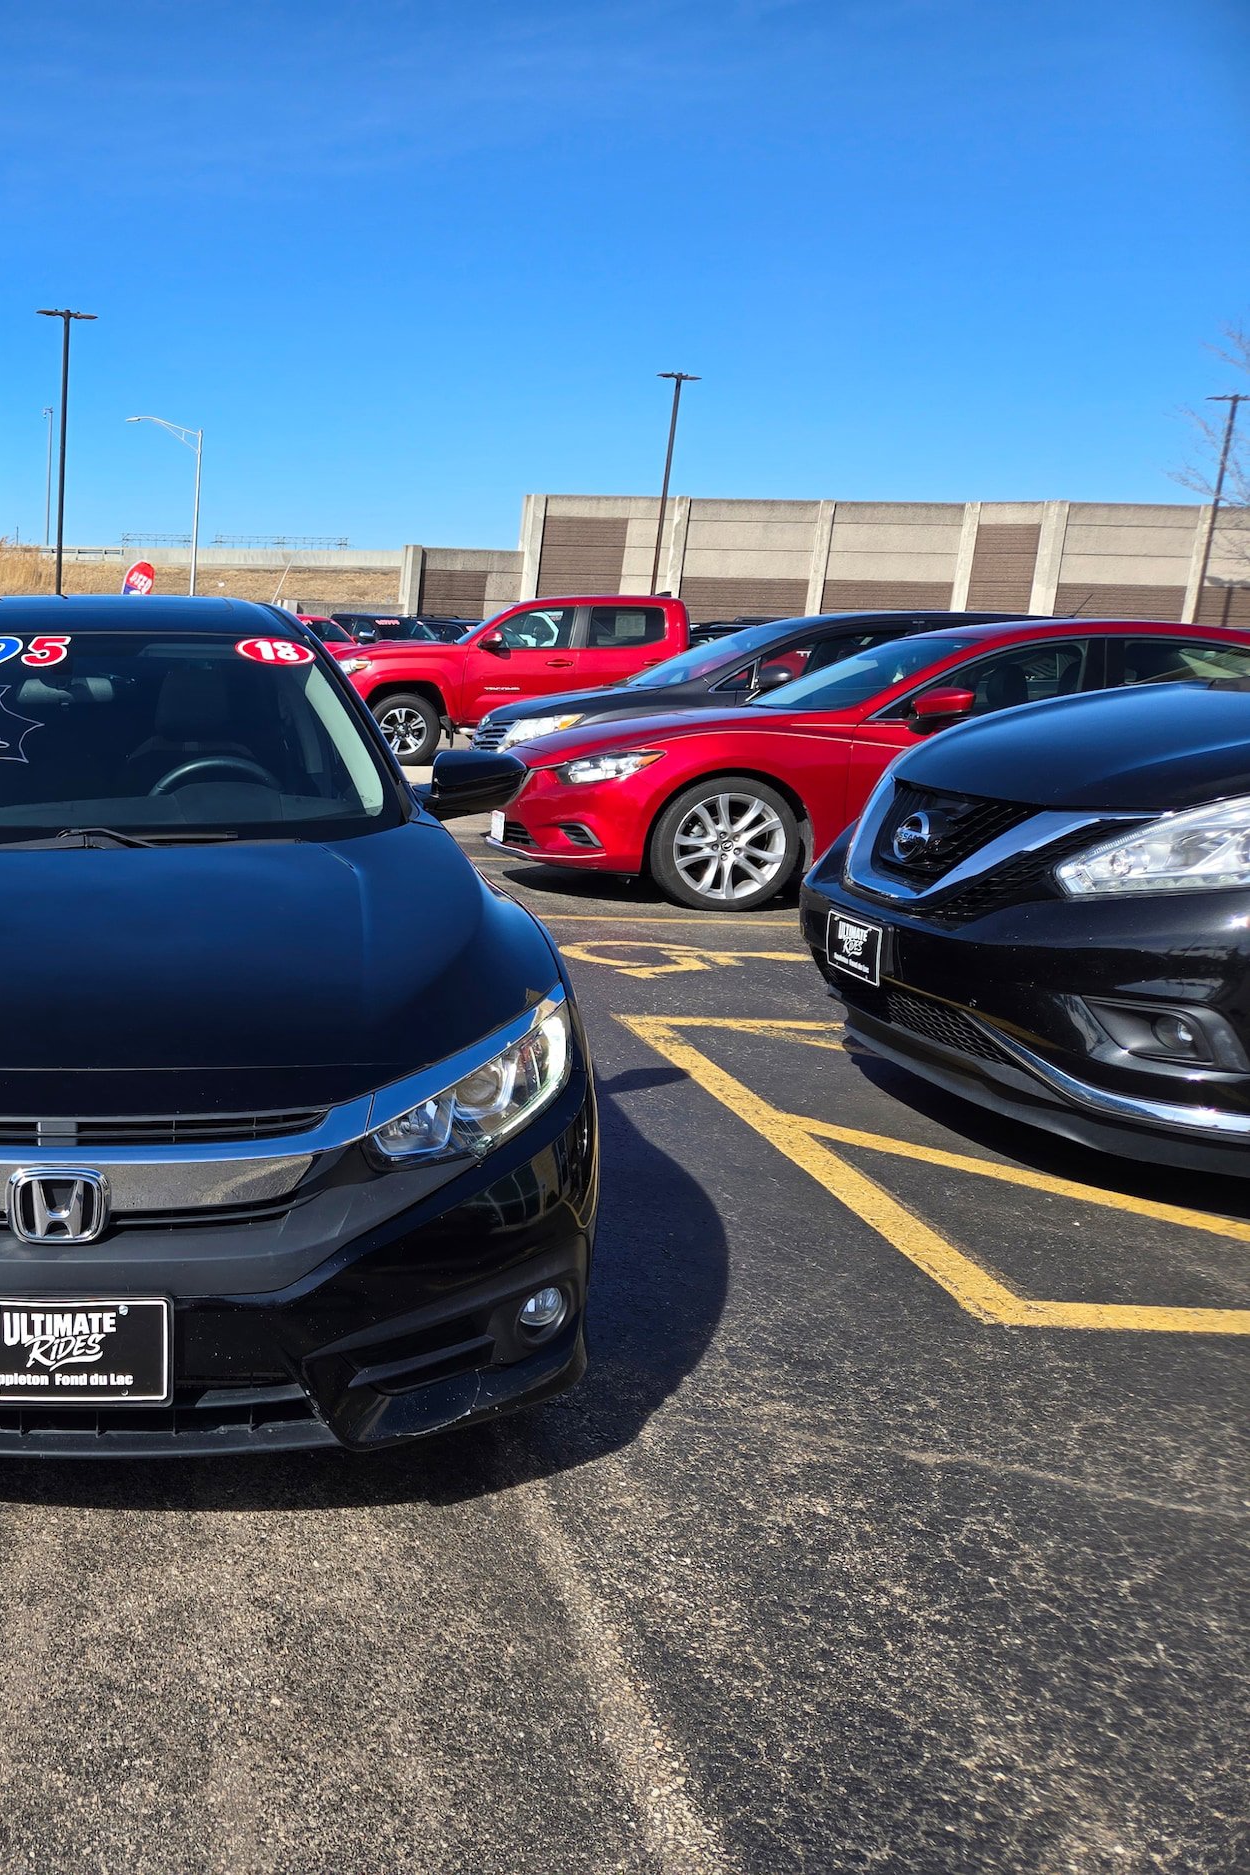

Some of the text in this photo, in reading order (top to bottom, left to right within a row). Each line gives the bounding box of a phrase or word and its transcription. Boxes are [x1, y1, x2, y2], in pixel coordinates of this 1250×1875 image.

[254, 640, 300, 661] 18
[838, 920, 868, 942] ULTIMATE
[3, 1311, 116, 1346] ULTIMATE
[24, 1333, 106, 1371] RIDES
[54, 1372, 88, 1386] Fond
[89, 1372, 108, 1386] du
[110, 1372, 134, 1386] Lac
